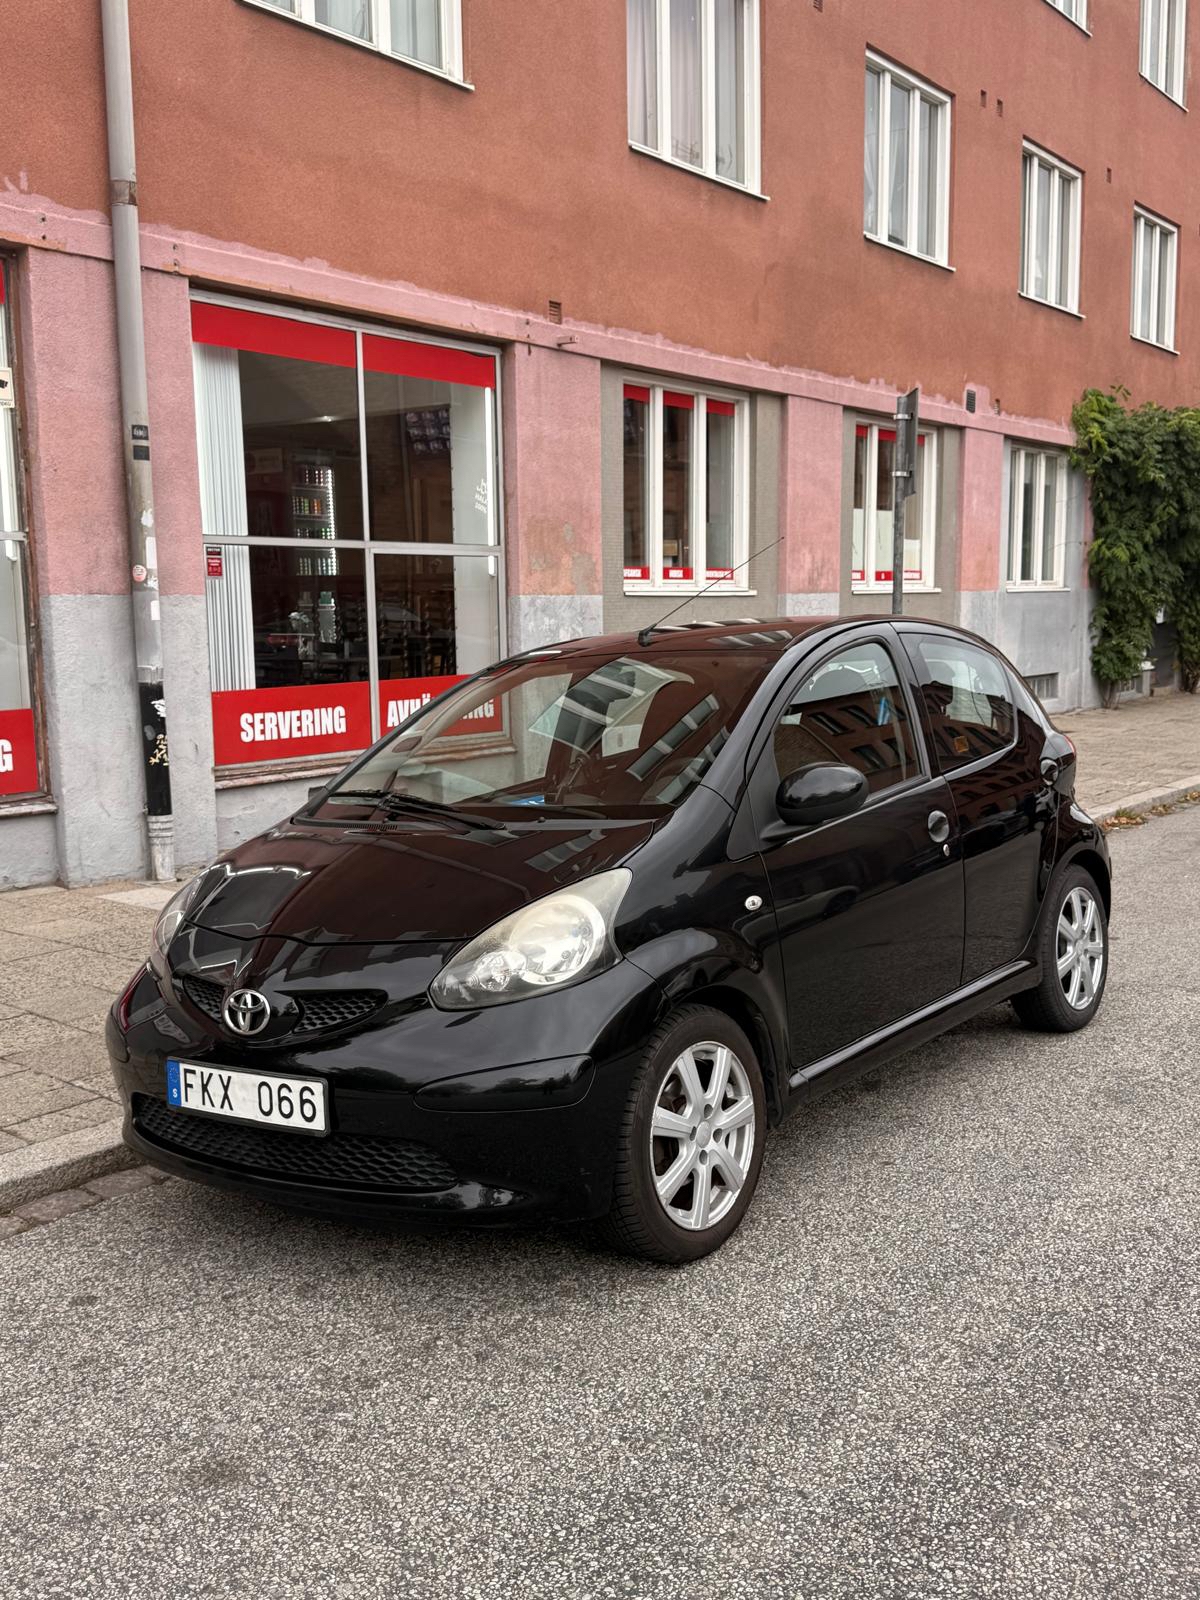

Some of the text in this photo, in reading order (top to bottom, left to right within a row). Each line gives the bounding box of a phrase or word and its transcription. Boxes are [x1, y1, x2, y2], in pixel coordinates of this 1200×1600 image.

[240, 705, 347, 743] SERVERING
[387, 693, 495, 728] AVHNG
[172, 1088, 178, 1098] S
[183, 1068, 317, 1123] FKX 066
